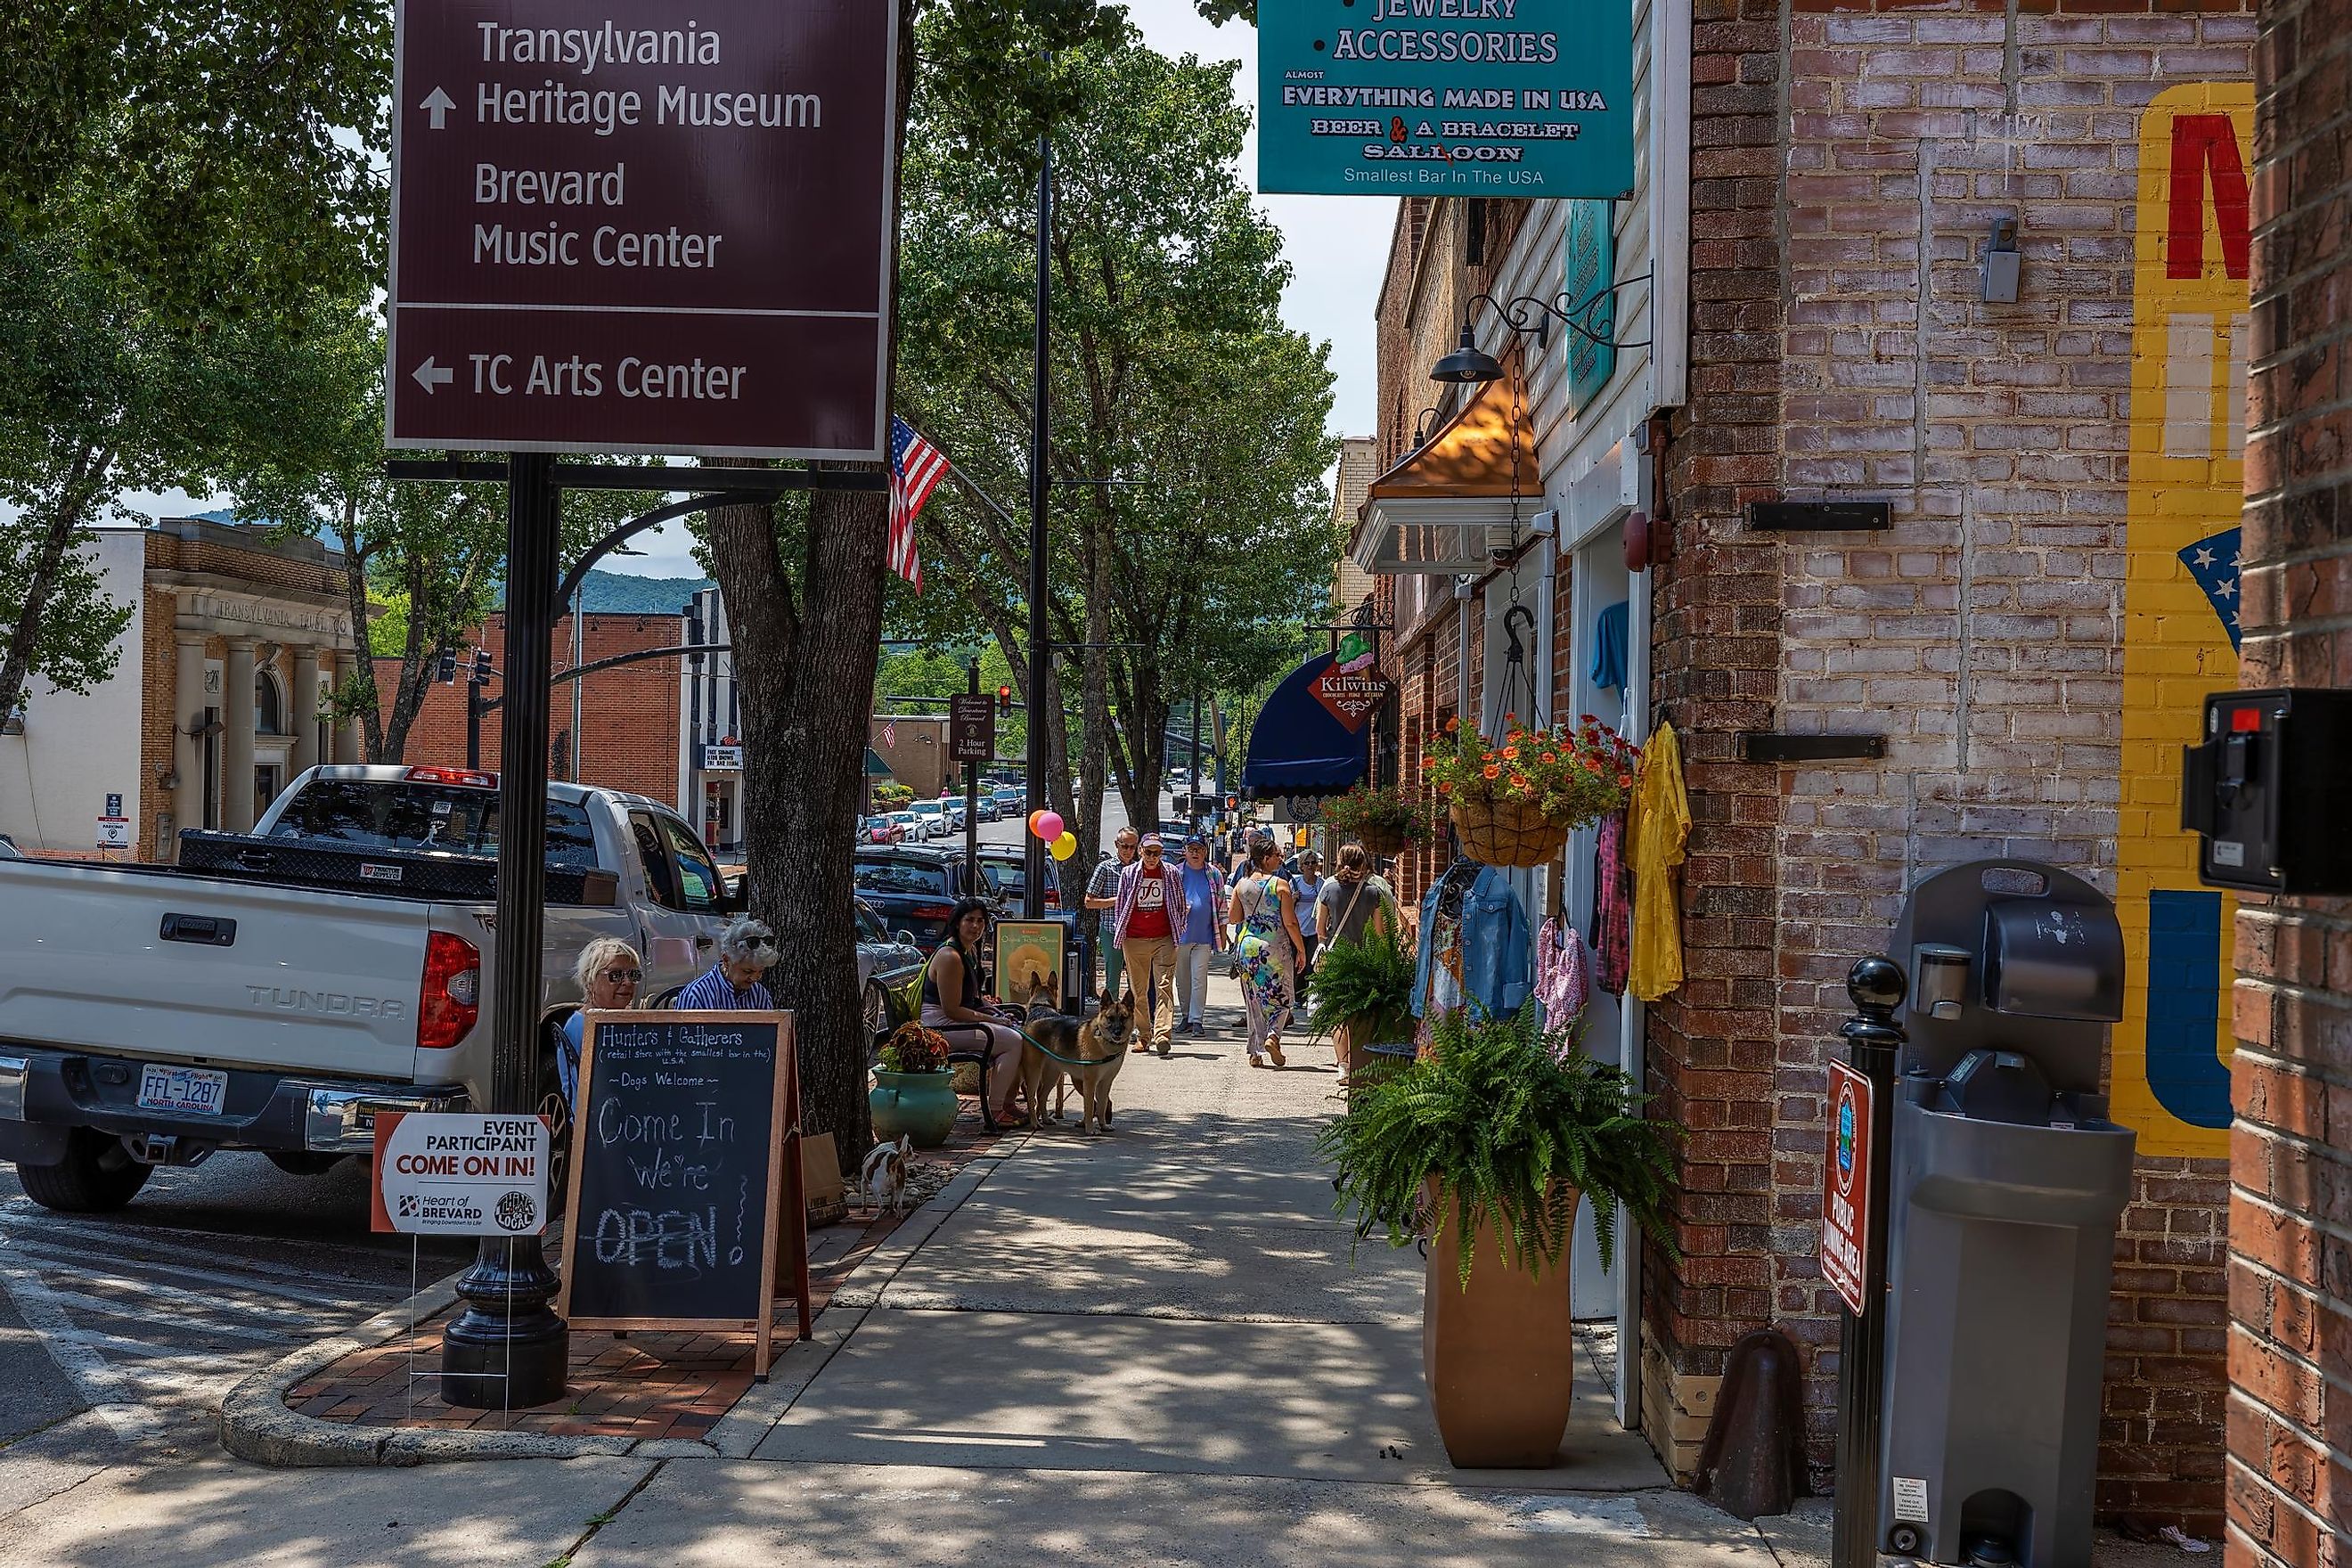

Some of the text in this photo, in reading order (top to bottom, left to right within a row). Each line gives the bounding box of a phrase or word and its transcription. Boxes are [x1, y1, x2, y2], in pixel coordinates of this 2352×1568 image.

[1373, 0, 1516, 21] JEWELRY
[478, 20, 721, 75] Transylvania
[1333, 29, 1557, 63] ACCESSORIES
[1285, 70, 1324, 80] ALMOST
[477, 80, 821, 135] Heritage Museum
[1283, 86, 1607, 110] EVERYTHING MADE IN USA
[1311, 116, 1580, 143] BEER & A BRACELET
[475, 162, 624, 206] Brevard
[1344, 167, 1544, 185] Smallest Bar In The USA
[473, 222, 722, 268] Music Center
[469, 354, 747, 399] TC Arts Center
[219, 600, 290, 627] TRANSYLVANIA
[1320, 677, 1386, 691] Kilwins
[958, 747, 987, 756] Parking
[959, 739, 985, 747] 2 Hour
[245, 984, 406, 1021] TUNDRA
[680, 1025, 744, 1046] Gatherers
[634, 1049, 652, 1058] store
[656, 1049, 672, 1058] with
[674, 1049, 687, 1058] the
[690, 1049, 723, 1058] smallest
[656, 1072, 704, 1086] Welcome
[143, 1076, 221, 1104] FFL-1287
[147, 1098, 214, 1111] NORTH CAROLINA
[484, 1121, 537, 1136] EVENT
[598, 1097, 735, 1148] Come In
[427, 1136, 537, 1152] PARTICIPANT
[396, 1155, 535, 1177] COME ON IN!
[423, 1196, 470, 1207] Heart of
[422, 1208, 482, 1219] BREVARD
[499, 1214, 532, 1229] LOCAL
[1833, 1190, 1854, 1237] PUBLIC
[1843, 1237, 1860, 1282] AREA
